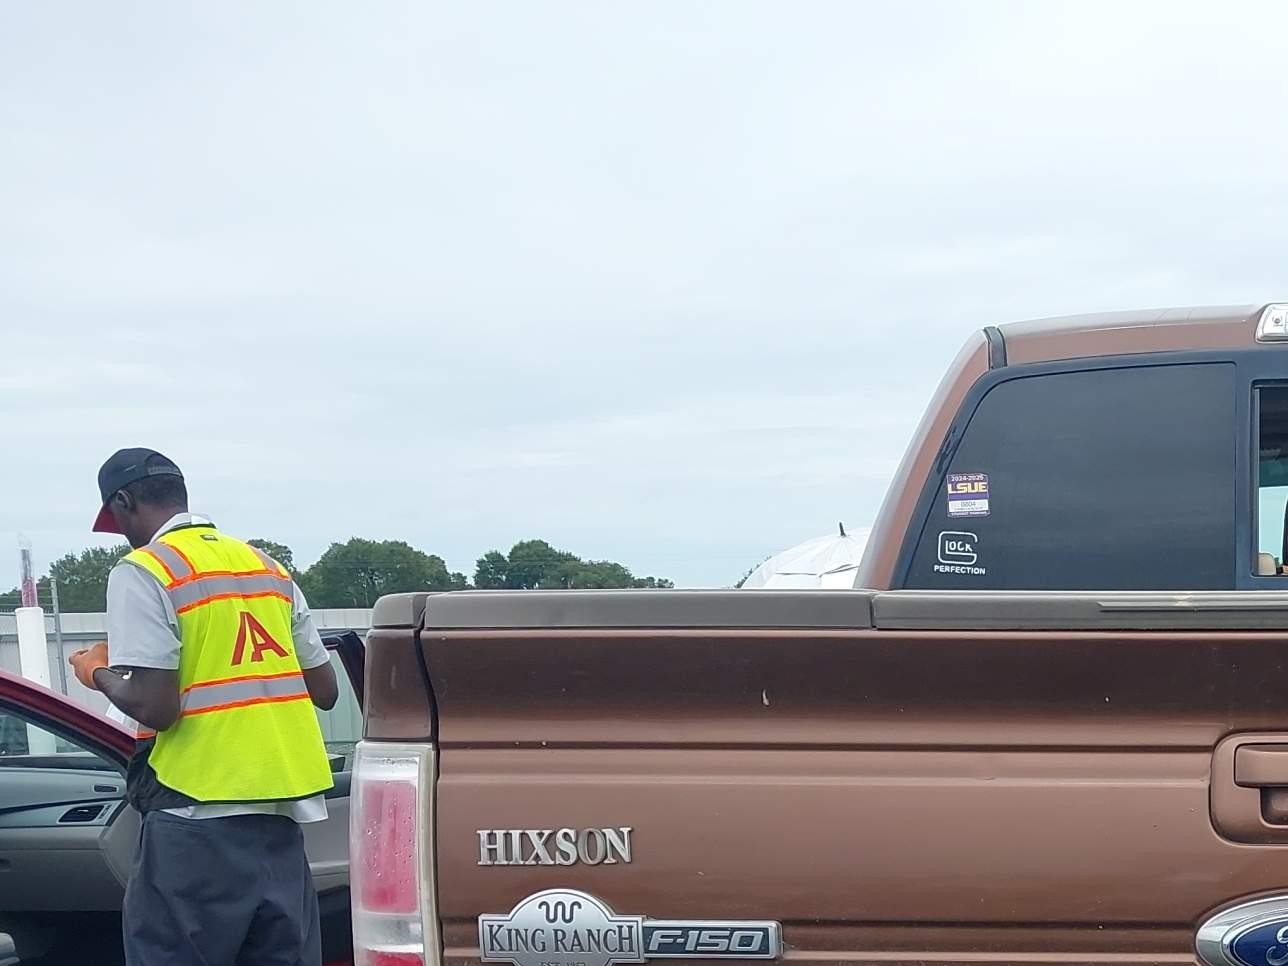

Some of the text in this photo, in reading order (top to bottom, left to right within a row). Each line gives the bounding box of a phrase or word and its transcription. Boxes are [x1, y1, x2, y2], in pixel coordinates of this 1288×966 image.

[948, 482, 988, 494] LSUE
[938, 531, 978, 565] GLOCK
[934, 565, 986, 575] PERFECTION
[476, 827, 633, 866] HIXSON
[488, 924, 635, 954] KING RANCH
[649, 930, 764, 951] F-150
